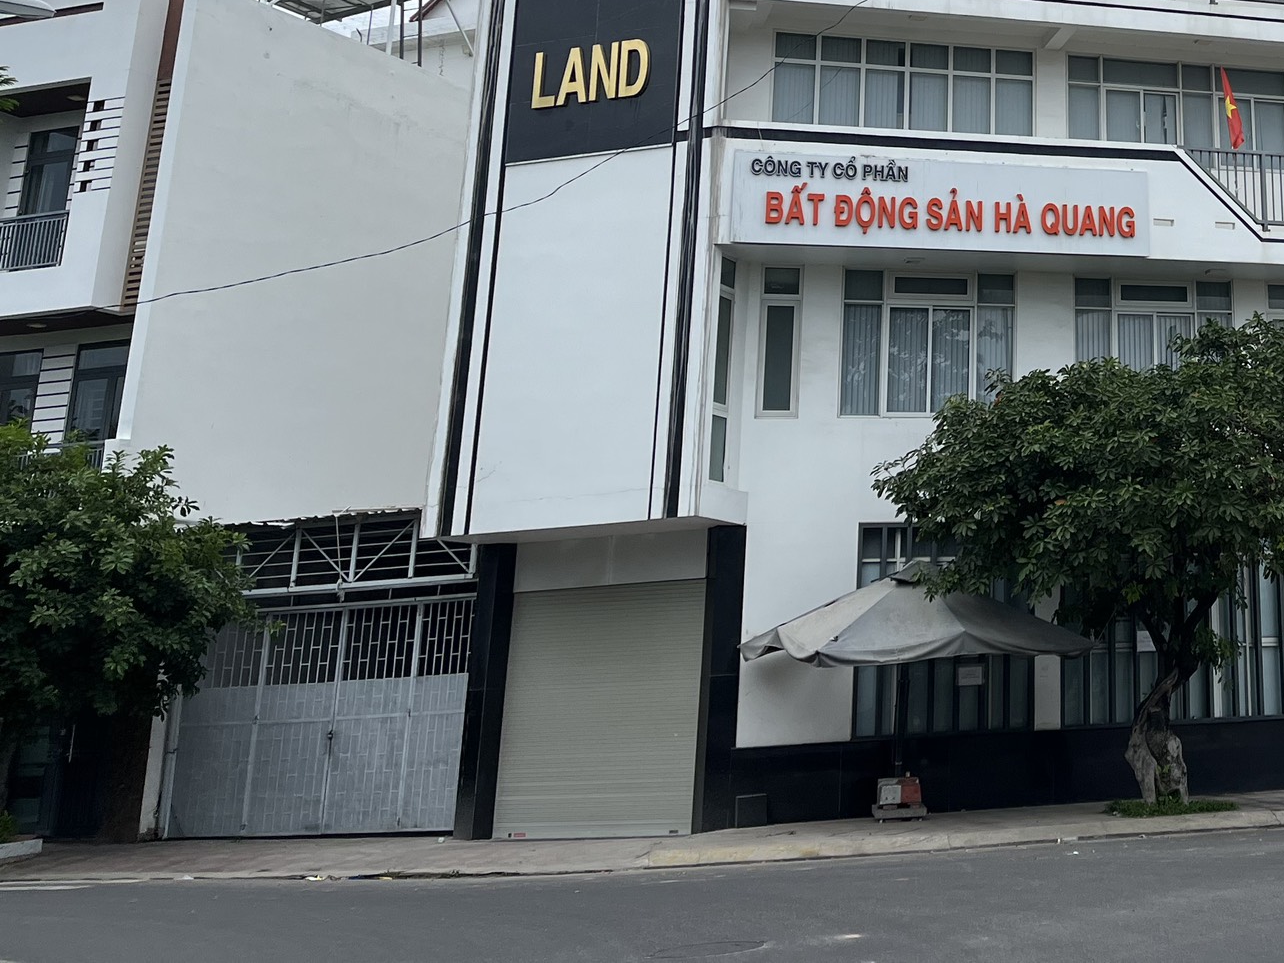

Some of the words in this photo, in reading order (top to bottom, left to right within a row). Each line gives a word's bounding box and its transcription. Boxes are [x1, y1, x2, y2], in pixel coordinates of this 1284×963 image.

[531, 38, 651, 110] LAND
[750, 156, 802, 178] CÔNG
[805, 161, 829, 179] TY
[832, 156, 858, 180] CỔ
[862, 158, 909, 183] PHẦN
[765, 182, 825, 226] BẤT
[834, 186, 918, 234] ĐỘNG
[925, 188, 983, 232] SẢN
[994, 193, 1032, 234] HÀ
[1040, 202, 1136, 238] QUANG
